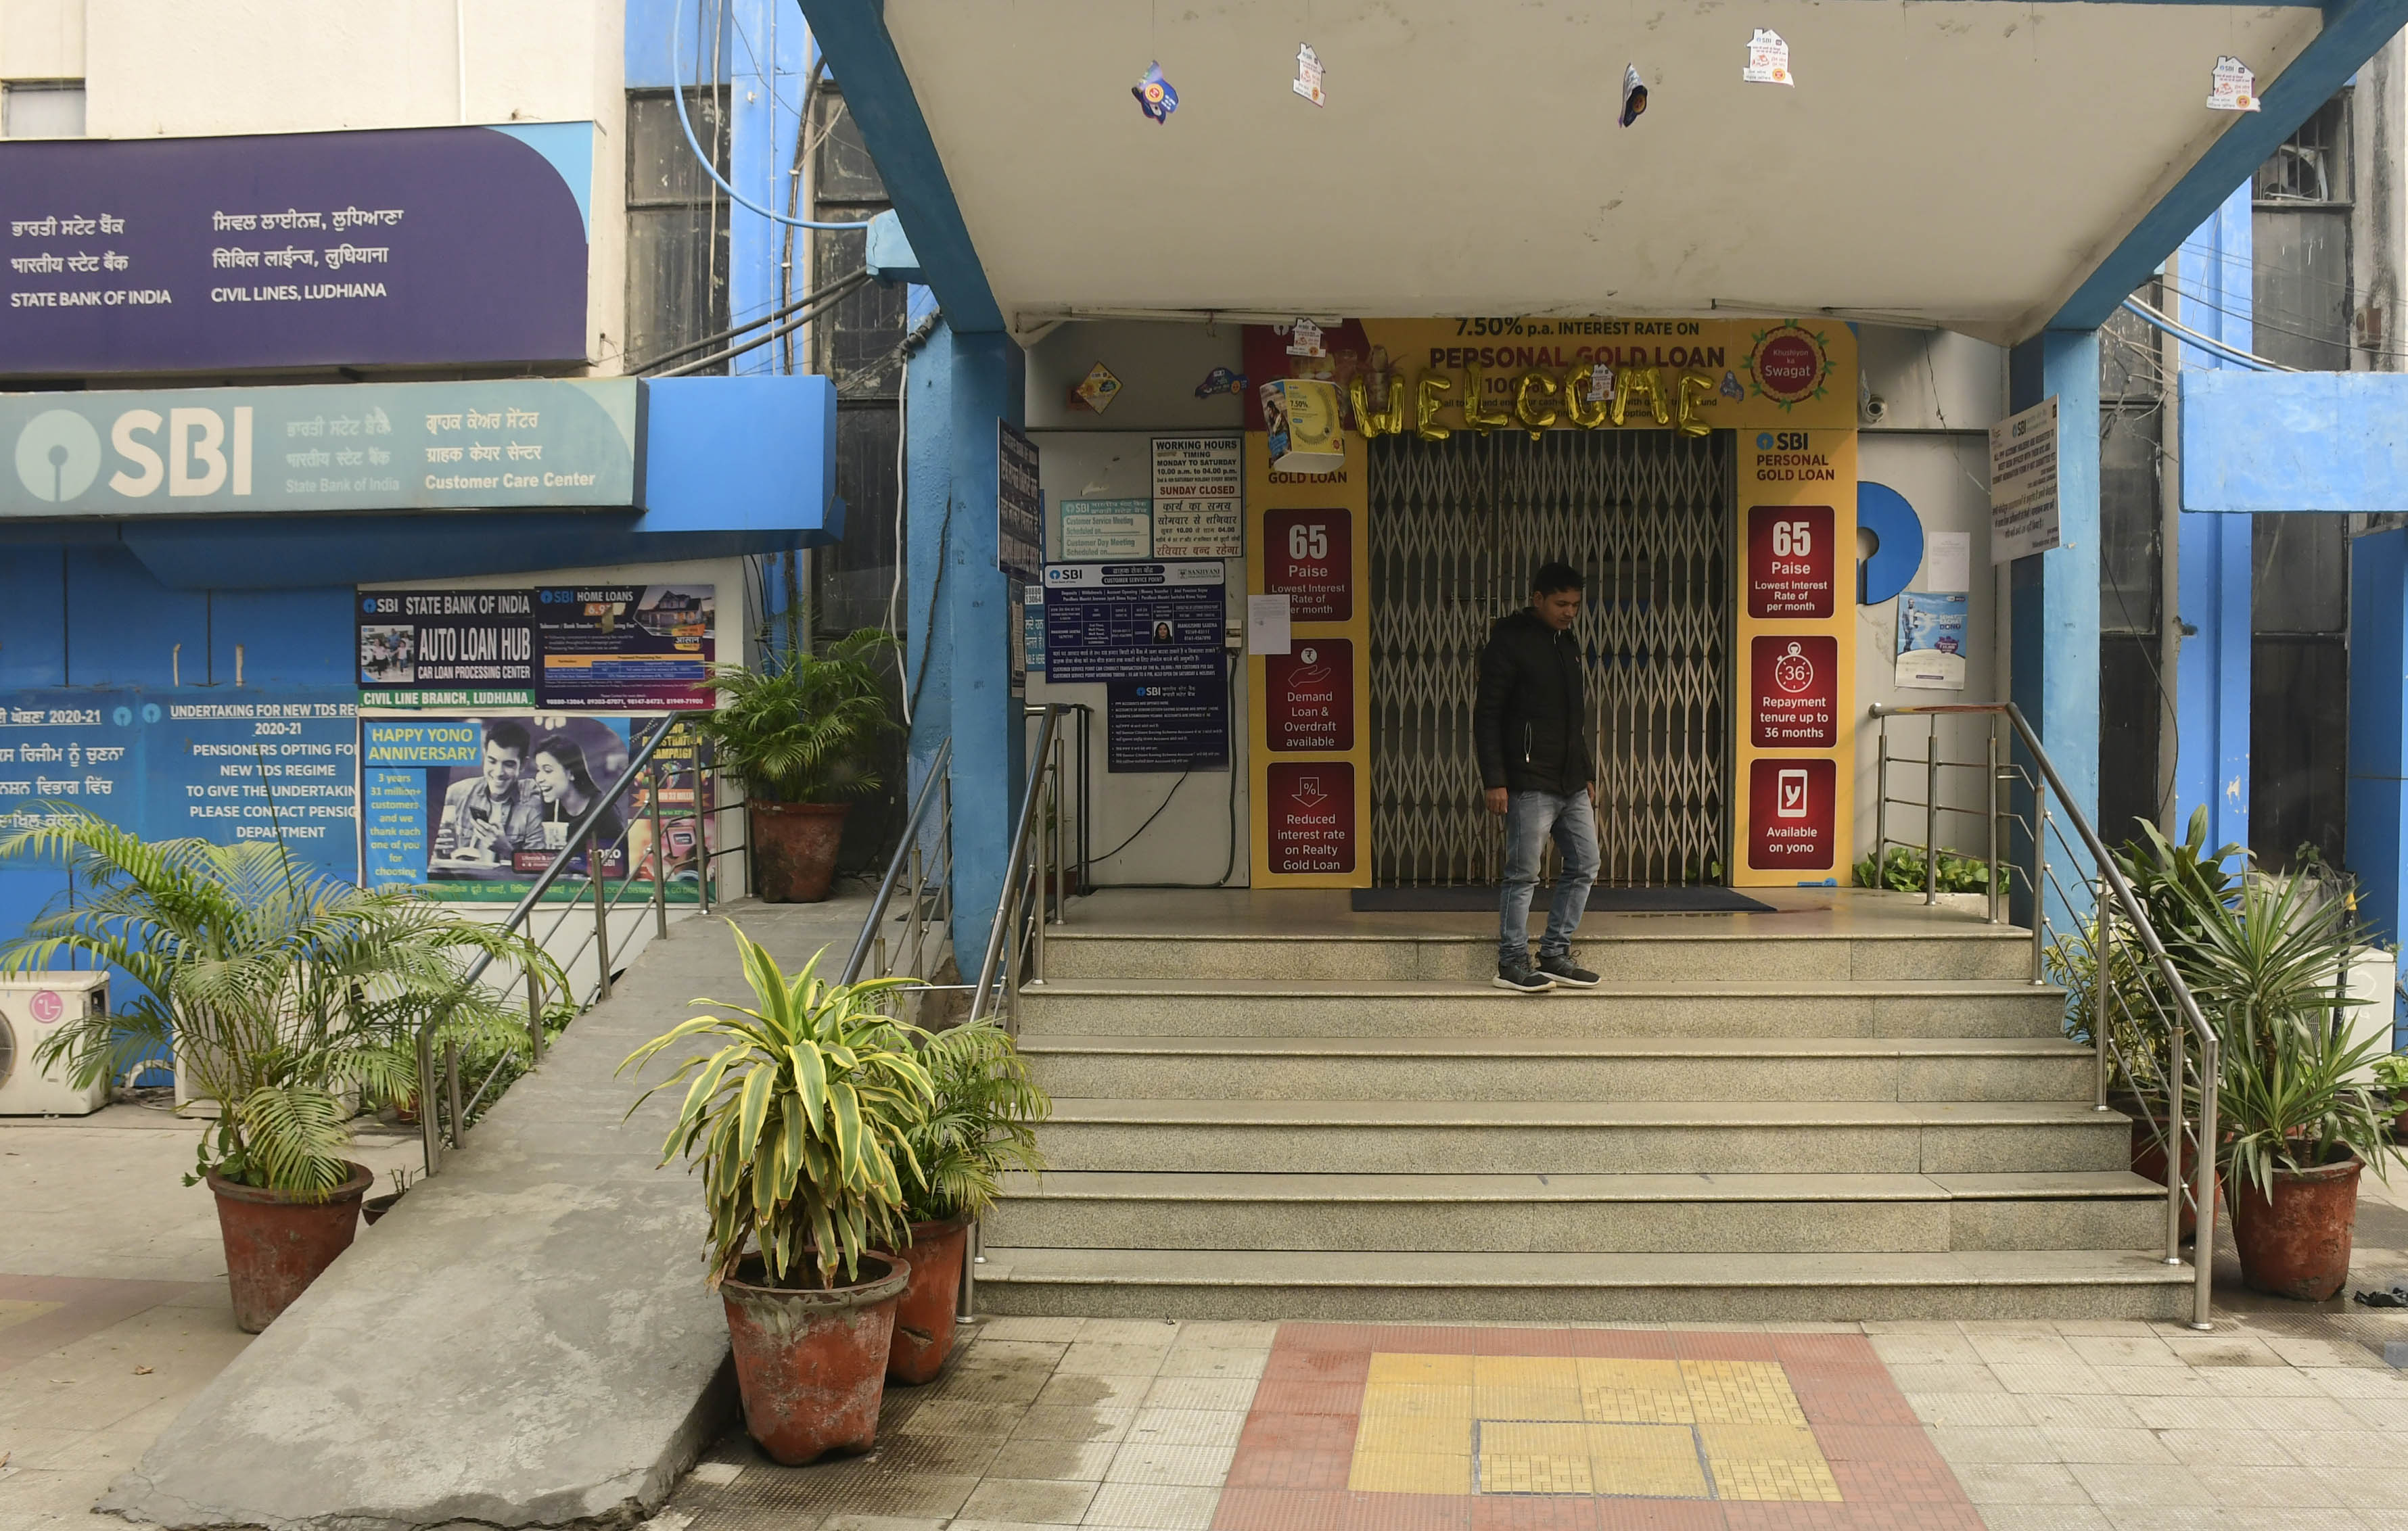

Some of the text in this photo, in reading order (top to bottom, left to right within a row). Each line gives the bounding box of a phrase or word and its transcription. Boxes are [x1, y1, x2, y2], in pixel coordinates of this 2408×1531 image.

[212, 211, 257, 231] ਸਿਵਲ
[332, 206, 404, 231] ਲੁਧਿਆਣਾ
[11, 213, 125, 237] ਭਾਰਤੀ ਸਟੇਟ ਬੈਂਕ
[11, 250, 129, 273] भारतीय स्टेट बैंक
[212, 243, 389, 270] सिविल लाईन्ज, लुधियाना
[11, 289, 172, 307] STATE BANK OF INDIA
[211, 283, 387, 302] CIVIL LINES, LUDHIANA
[1455, 316, 1699, 338] 7.50% p.a. INTEREST RATE ON
[1430, 346, 1725, 369] PERSONAL GOLD LOAN
[1773, 348, 1809, 358] Khushiyon
[1765, 365, 1811, 379] Swagat
[1349, 360, 1715, 441] WELCOME
[1157, 441, 1237, 450] WORKING HOURS
[1777, 433, 1808, 450] SBI
[108, 406, 252, 498] SBI
[425, 441, 501, 464] ग्राहक केयर
[1757, 454, 1829, 466] PERSONAL
[425, 471, 596, 491] Customer Care Center
[1269, 471, 1347, 484] GOLD LOAN
[1757, 469, 1834, 481] GOLD LOAN
[286, 477, 400, 494] State Bank of India
[1160, 486, 1235, 495] SUNDAY CLOSED
[1075, 503, 1089, 513] SBI
[1163, 500, 1232, 511] कार्य का समय
[1289, 525, 1328, 560] 65
[1773, 521, 1811, 557] 65
[1289, 565, 1328, 577] Paise
[1772, 561, 1811, 574] Paise
[1063, 570, 1082, 580] SBI
[1272, 584, 1345, 593] Lowest Interest
[1755, 581, 1828, 590] Lowest Interest
[553, 590, 633, 603] SBI HOME LOANS
[1292, 594, 1326, 603] Rate of
[1774, 592, 1808, 600] Rate of
[377, 595, 530, 615] SBI STATE BANK OF INDIA
[1302, 606, 1333, 614] month
[1767, 603, 1815, 613] per month
[419, 628, 457, 661] AUTO
[461, 628, 496, 661] LOAN
[502, 627, 531, 661] HUB
[418, 666, 433, 679] CAR
[434, 666, 453, 679] LOAN
[455, 666, 501, 679] PROCESSING
[503, 665, 530, 678] CENTER
[1785, 665, 1805, 681] 36
[1147, 687, 1161, 696] SBI
[1288, 692, 1333, 702] Demand
[363, 692, 528, 706] CIVIL LINE BRANCH, LUDHIANA
[1763, 697, 1826, 709] Repayment
[49, 709, 101, 723] 2020-21
[170, 705, 254, 717] UNDERTAKING
[256, 705, 280, 717] FOR
[283, 704, 311, 717] NEW
[314, 704, 337, 716] TDS
[1292, 707, 1329, 717] Loan &
[1760, 713, 1828, 725] tenure up to
[254, 722, 302, 735] 2020-21
[1284, 722, 1336, 732] Overdraft
[1765, 728, 1824, 738] 36 months
[373, 728, 473, 743] HAPPY YONO
[1287, 737, 1335, 747] available
[193, 744, 332, 757] PENSIONERS OPTING
[369, 746, 476, 761] ANNIVERSARY
[221, 765, 336, 776] NEW TDS REGIME
[378, 774, 411, 786] 3 years
[185, 786, 204, 797] TO
[208, 785, 239, 797] GIVE
[242, 786, 269, 797] THE
[370, 786, 421, 796] 31 million+
[371, 800, 419, 810] customers
[190, 805, 305, 818] PLEASE CONTACT
[379, 813, 398, 823] and
[1287, 814, 1335, 824] Reduced
[237, 826, 326, 839] DEPARTMENT
[370, 826, 421, 837] thank each
[1278, 830, 1345, 840] interest rate
[1766, 827, 1817, 837] Available
[371, 840, 420, 853] one of you
[1303, 845, 1337, 857] Realty
[1787, 845, 1813, 855] yono
[389, 853, 403, 863] for
[1283, 859, 1340, 870] Gold Loan
[375, 866, 417, 878] choosing
